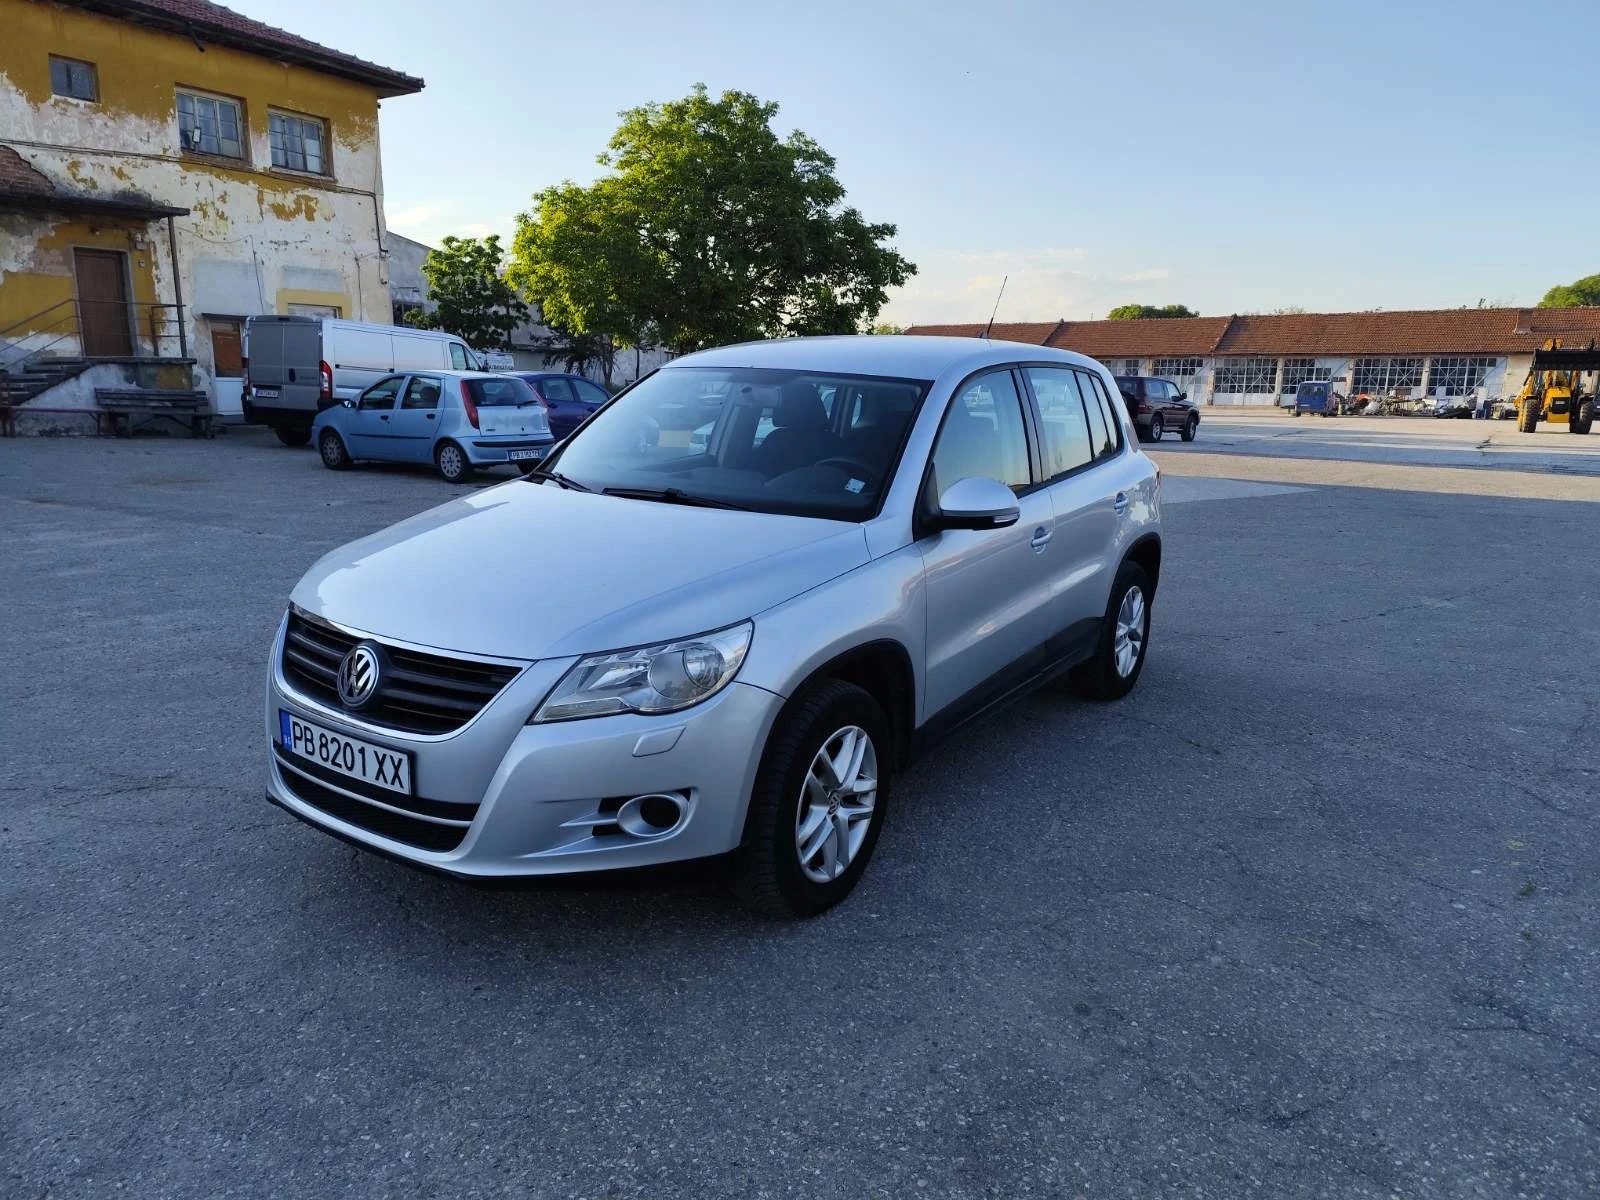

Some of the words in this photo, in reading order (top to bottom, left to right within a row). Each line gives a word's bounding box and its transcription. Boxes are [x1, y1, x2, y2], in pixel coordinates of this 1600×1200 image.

[292, 720, 315, 756] PB
[318, 732, 367, 777] 8201
[373, 750, 404, 789] XX
